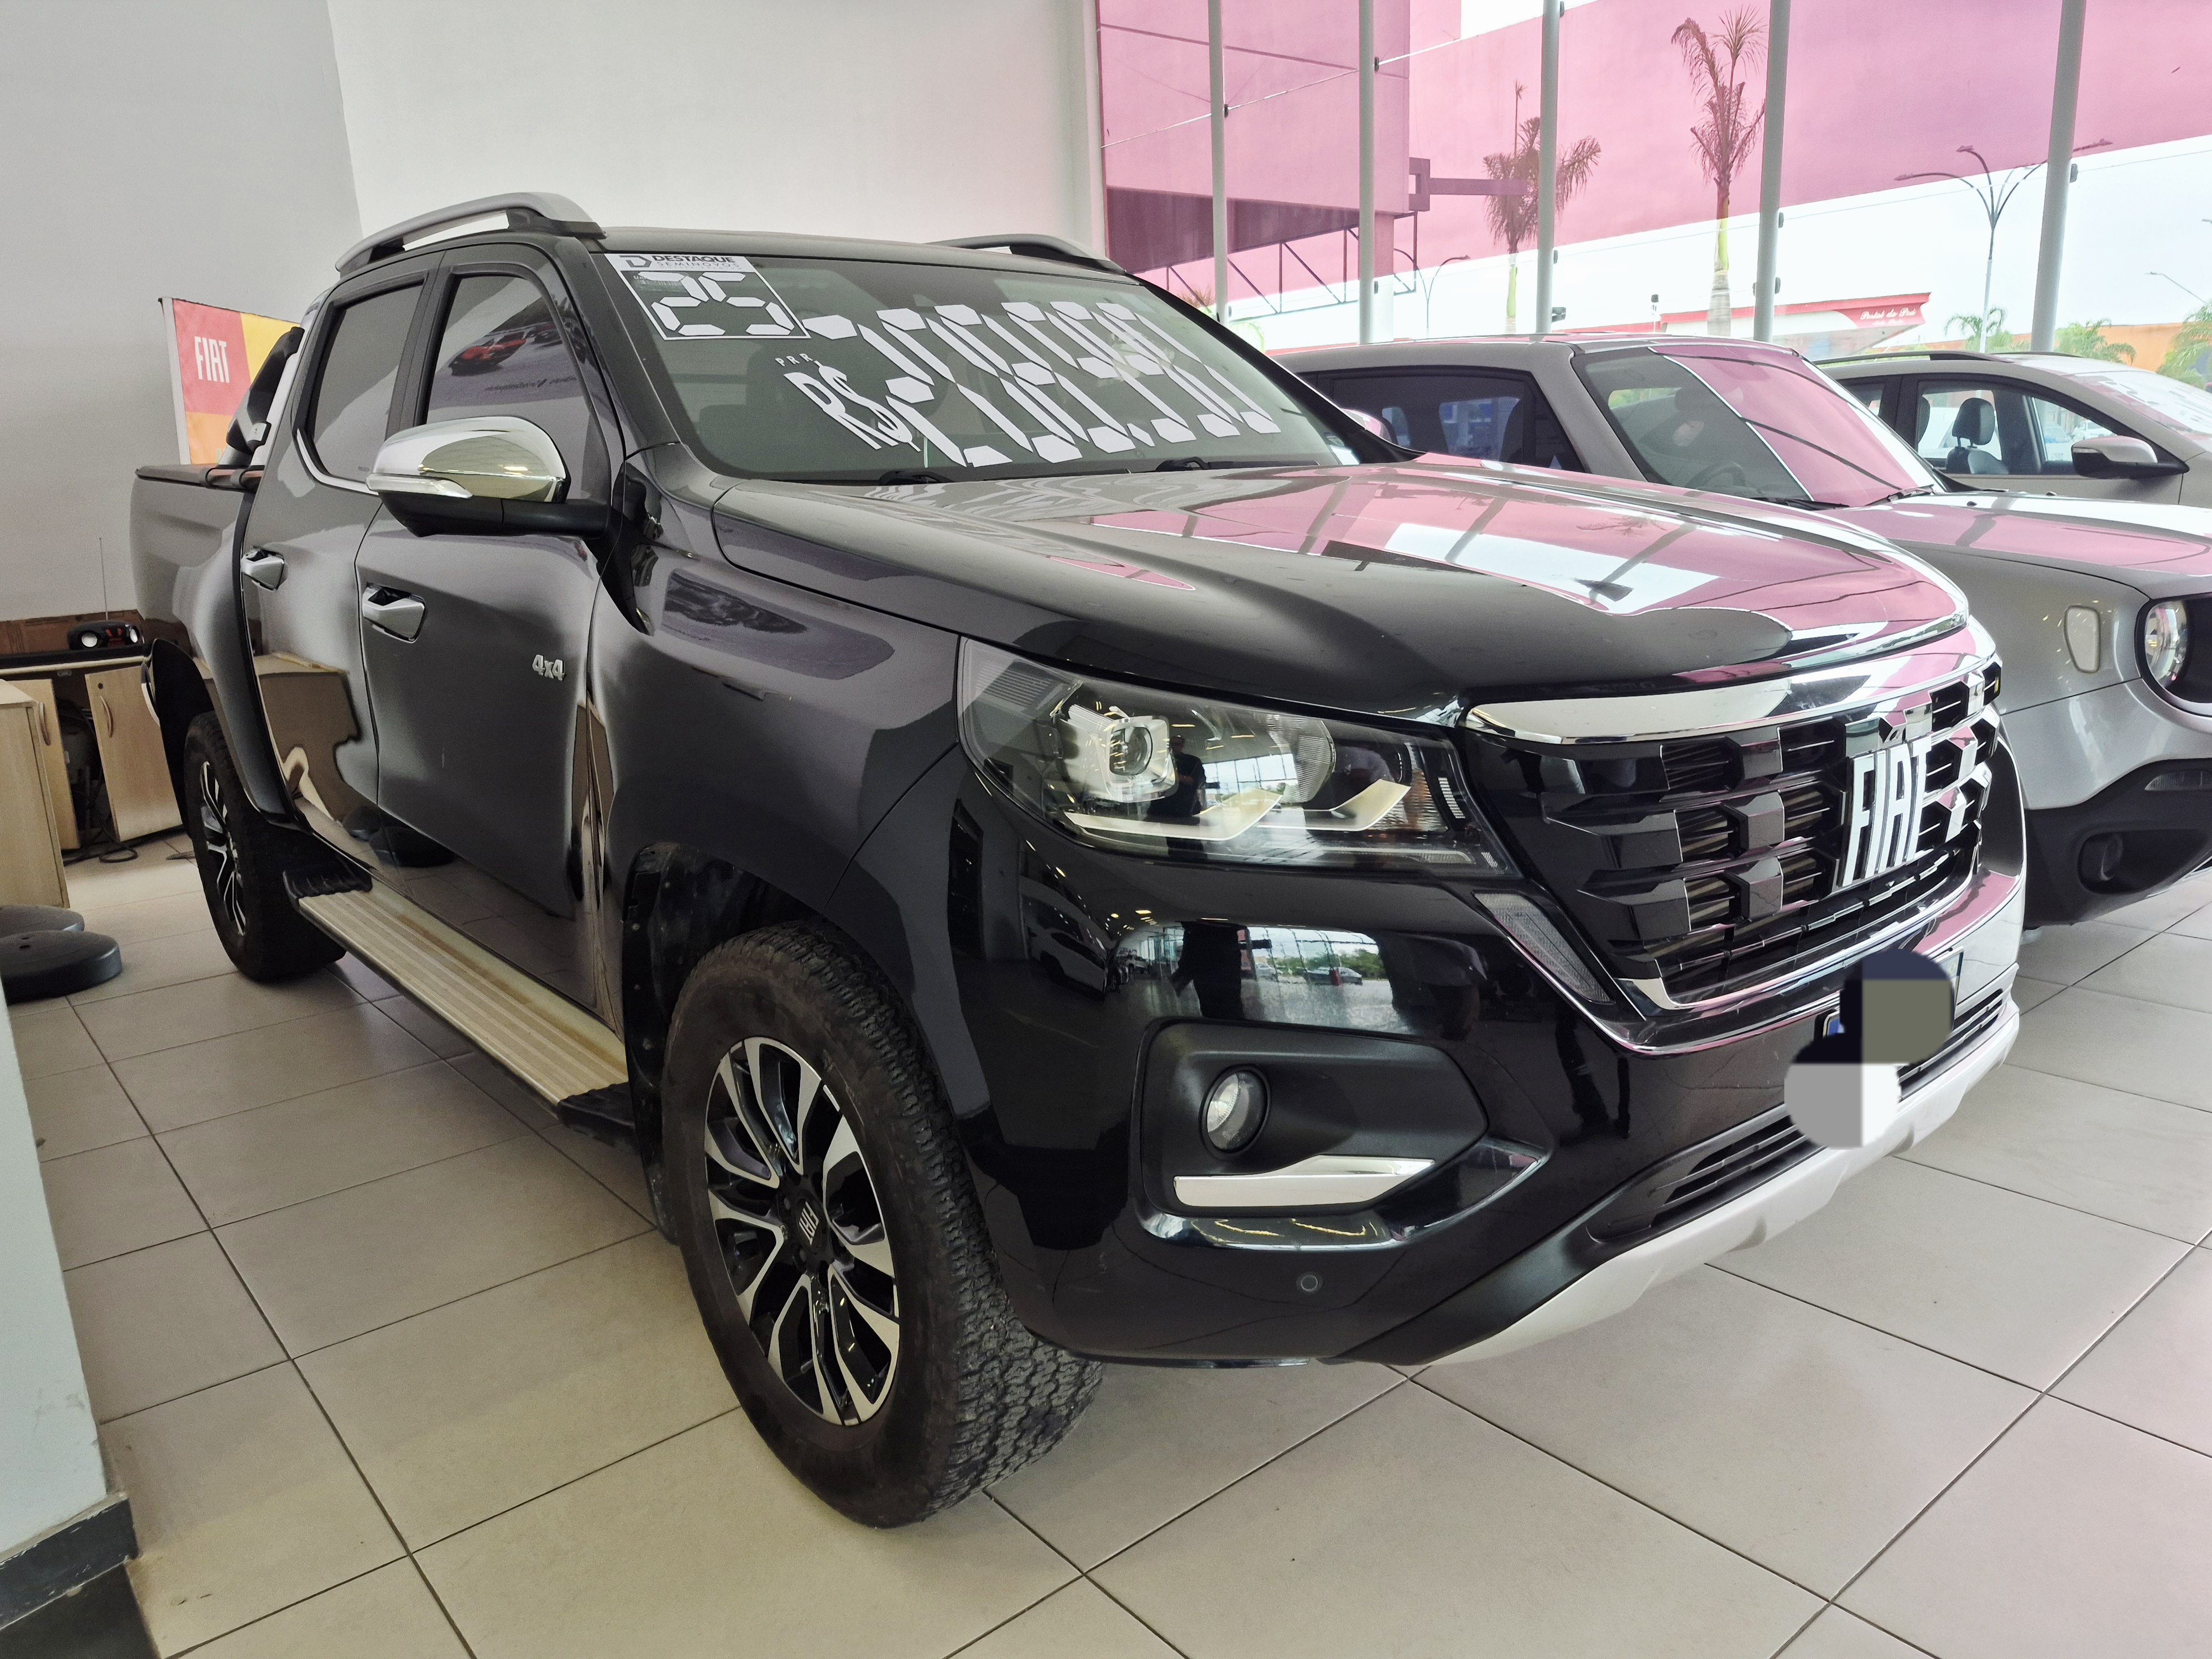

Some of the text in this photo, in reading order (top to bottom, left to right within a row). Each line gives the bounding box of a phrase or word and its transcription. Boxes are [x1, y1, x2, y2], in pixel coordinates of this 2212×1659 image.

[651, 255, 736, 263] DESTAQUE
[637, 271, 796, 336] 25
[194, 335, 230, 384] FIAT
[783, 301, 1282, 468] R$ 208.990
[532, 654, 565, 681] 4x4
[1842, 735, 1932, 887] FIAT
[799, 1201, 820, 1246] FIAT
